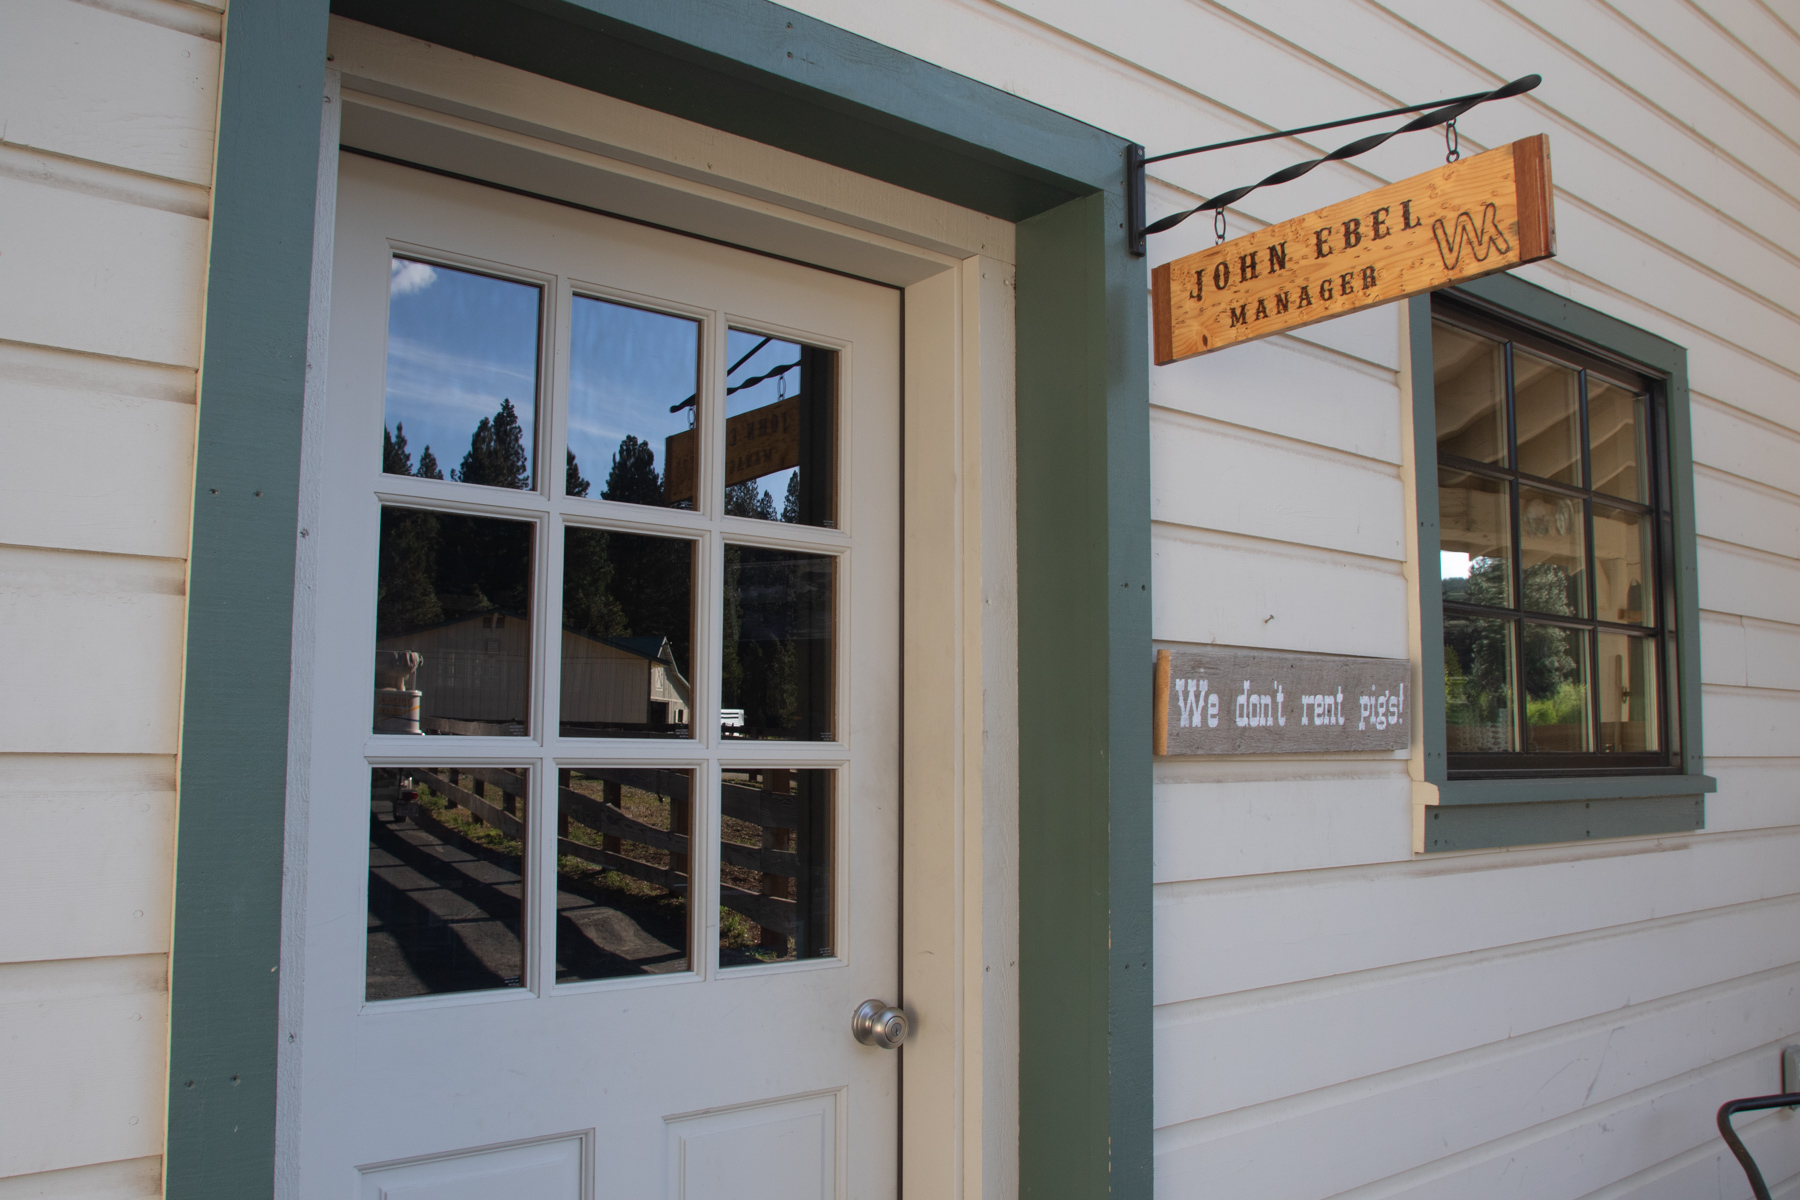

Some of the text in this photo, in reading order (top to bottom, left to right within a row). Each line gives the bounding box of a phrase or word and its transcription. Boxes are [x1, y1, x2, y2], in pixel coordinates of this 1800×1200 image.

[1189, 199, 1423, 302] JOHN EBEL
[1229, 265, 1378, 328] MANAGER
[1175, 678, 1404, 731] We don't rent pigs!
